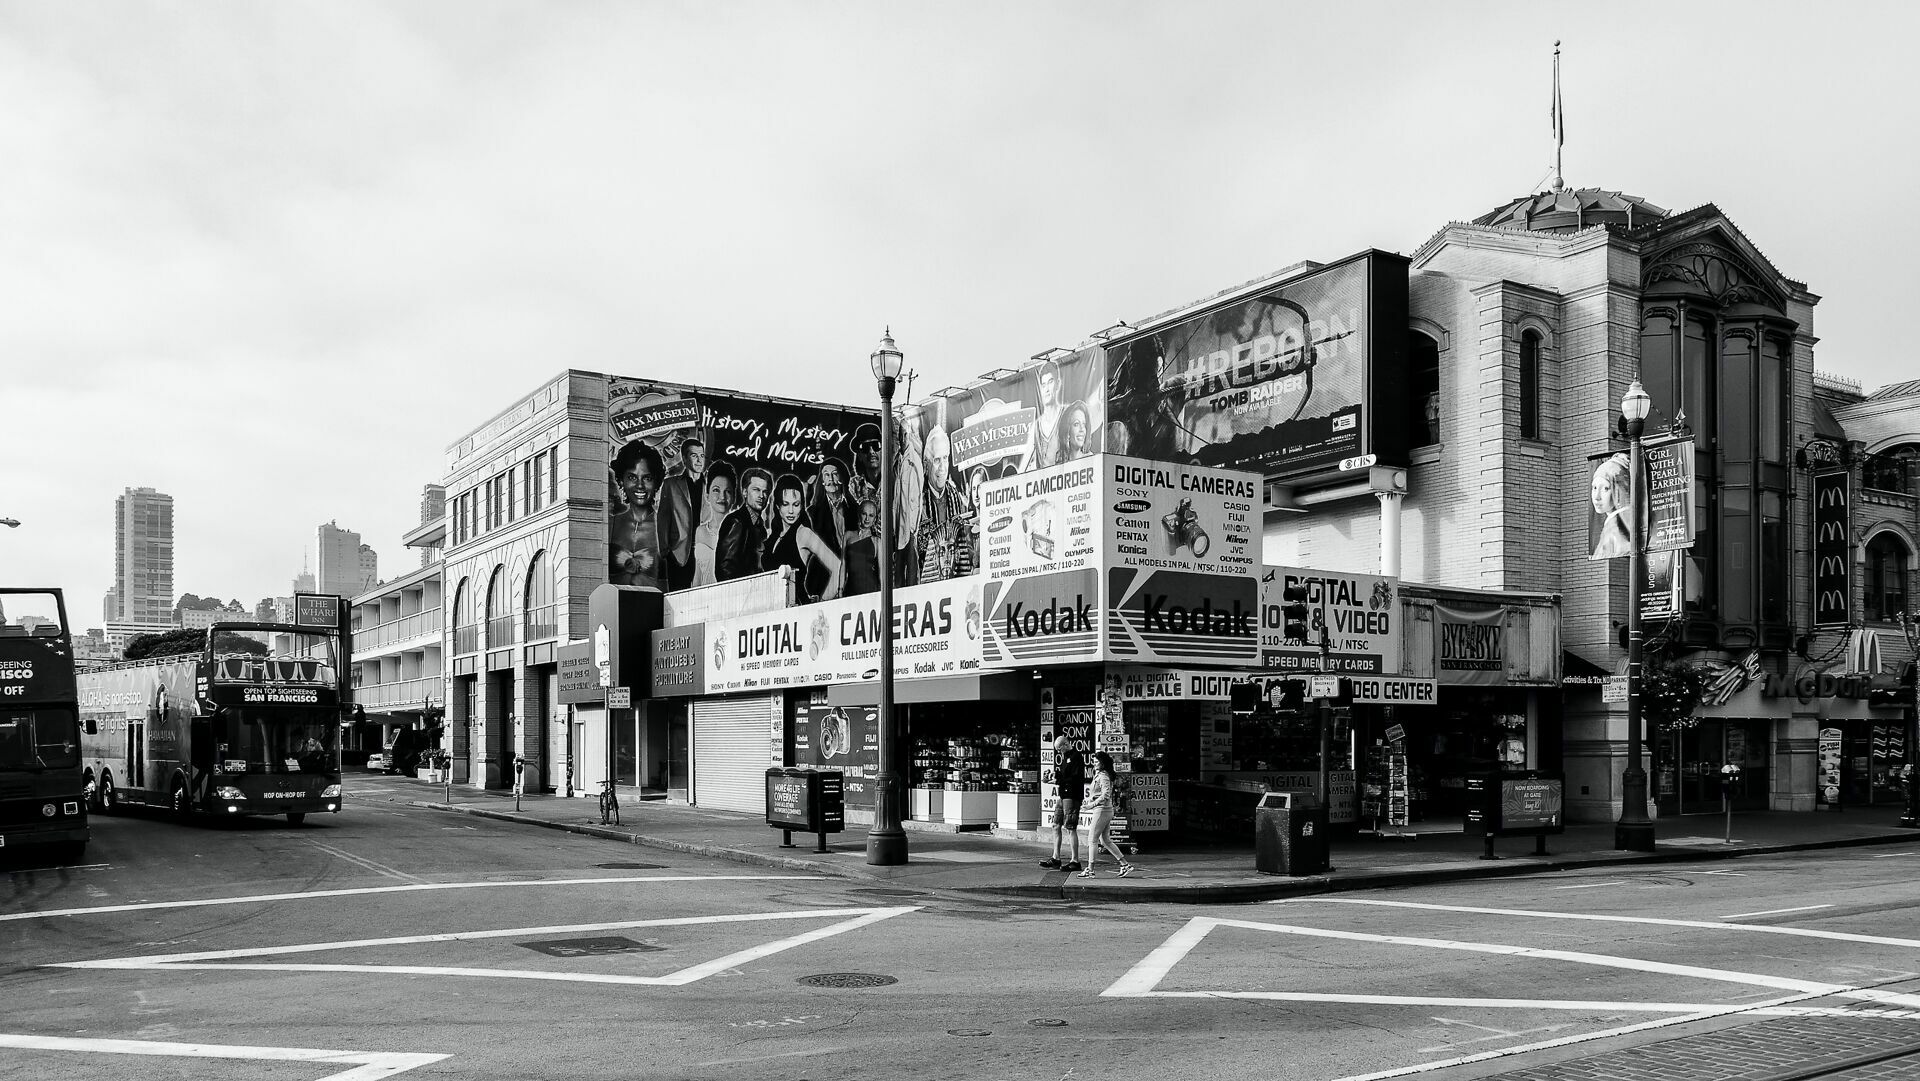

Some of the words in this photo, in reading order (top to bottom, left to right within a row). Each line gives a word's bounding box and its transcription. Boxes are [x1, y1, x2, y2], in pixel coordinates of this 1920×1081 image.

[1184, 310, 1358, 400] #REBORN
[1210, 391, 1248, 412] TOMB
[1250, 376, 1303, 402] RAIDER
[1234, 406, 1250, 416] NOW
[1250, 397, 1282, 412] AVAILABLE
[616, 416, 645, 431] WAX
[645, 407, 696, 422] MUSEUM
[702, 406, 768, 440] History,
[778, 417, 848, 449] Mystery
[953, 434, 982, 454] WAX
[982, 422, 1032, 444] MUSEUM
[726, 436, 762, 460] and
[768, 440, 824, 464] Movies
[1354, 456, 1370, 467] CBS
[1650, 458, 1674, 470] WITH
[1676, 456, 1683, 466] A
[1651, 468, 1678, 480] PEARL
[986, 484, 1022, 507] DIGITAL
[1026, 466, 1094, 498] CAMCORDER
[1114, 464, 1174, 489] DIGITAL
[1181, 473, 1254, 499] CAMERAS
[1652, 474, 1690, 490] EARRING
[1067, 492, 1091, 503] CASIO
[1116, 488, 1149, 498] SONY
[989, 507, 1011, 518] SONY
[1071, 503, 1086, 513] FUJI
[1116, 502, 1148, 512] SAMSUNG
[1224, 502, 1250, 512] CASIO
[1115, 516, 1150, 529] Canon
[1228, 513, 1245, 522] FUJI
[1070, 526, 1090, 536] Nikon
[1222, 524, 1251, 533] MINOLTA
[988, 535, 1012, 545] Canon
[1116, 531, 1148, 542] PENTAX
[1225, 534, 1249, 544] Nikon
[1073, 538, 1085, 547] JVC
[989, 546, 1010, 557] PENTAX
[1065, 547, 1094, 558] OLYMPUS
[1118, 544, 1147, 555] Konica
[1230, 546, 1244, 555] JVC
[990, 558, 1010, 569] Konica
[1124, 556, 1136, 565] ALL
[1138, 557, 1167, 567] MODELS
[1169, 560, 1177, 568] IN
[1178, 560, 1190, 570] PAL
[1198, 562, 1215, 572] NTSC
[1220, 564, 1247, 574] 110-220
[1220, 555, 1253, 565] OLYMPUS
[990, 568, 1000, 579] ALL
[1000, 566, 1021, 577] MODELS
[1028, 564, 1038, 573] PAL
[1043, 562, 1057, 572] NTSC
[1062, 558, 1084, 569] 110-220
[308, 600, 328, 608] THE
[301, 608, 335, 616] WHARF
[1006, 594, 1092, 638] Kodak
[1144, 594, 1252, 637] Kodak
[1334, 609, 1389, 634] VIDEO
[739, 622, 802, 658] DIGITAL
[840, 597, 951, 646] CAMERAS
[659, 639, 675, 652] FINE
[676, 636, 690, 650] ART
[1345, 639, 1368, 650] NTSC
[1441, 623, 1468, 659] BYE
[1477, 625, 1500, 660] BYE
[842, 651, 854, 661] FULL
[856, 650, 868, 659] LINE
[870, 649, 877, 657] OF
[904, 641, 948, 654] ACCESSORIES
[655, 654, 688, 669] ANTIQUES
[746, 662, 760, 670] SPEED
[763, 659, 782, 668] MEMORY
[1269, 656, 1298, 668] SPEED
[1302, 657, 1341, 669] MEMRY
[1345, 660, 1374, 670] CARDS
[1459, 661, 1501, 669] FRANCISCO
[655, 671, 694, 686] FURNITURE
[744, 678, 757, 687] Nikon
[761, 678, 770, 686] FUJI
[774, 677, 789, 685] PENTAX
[814, 673, 832, 681] CASIO
[914, 661, 936, 673] Kodak
[942, 662, 953, 671] JVC
[1127, 674, 1143, 682] ALL
[1147, 673, 1180, 682] DIGITAL
[1588, 676, 1592, 684] &
[4, 686, 24, 695] OFF
[278, 688, 317, 696] SIGHTSEEING
[1126, 685, 1143, 697] ON
[1147, 683, 1181, 697] SALE
[1353, 681, 1379, 699] DEO
[1384, 682, 1432, 700] CENTER
[82, 692, 102, 706] ALOHA
[105, 691, 110, 704] is
[244, 694, 265, 702] SAN
[1042, 713, 1053, 722] SALE
[1059, 712, 1093, 725] CANON
[1063, 726, 1088, 738] SONY
[865, 734, 877, 742] FUJI
[1042, 752, 1053, 762] SALE
[1132, 777, 1166, 786] IGITAL
[1263, 776, 1312, 787] DIGITAL
